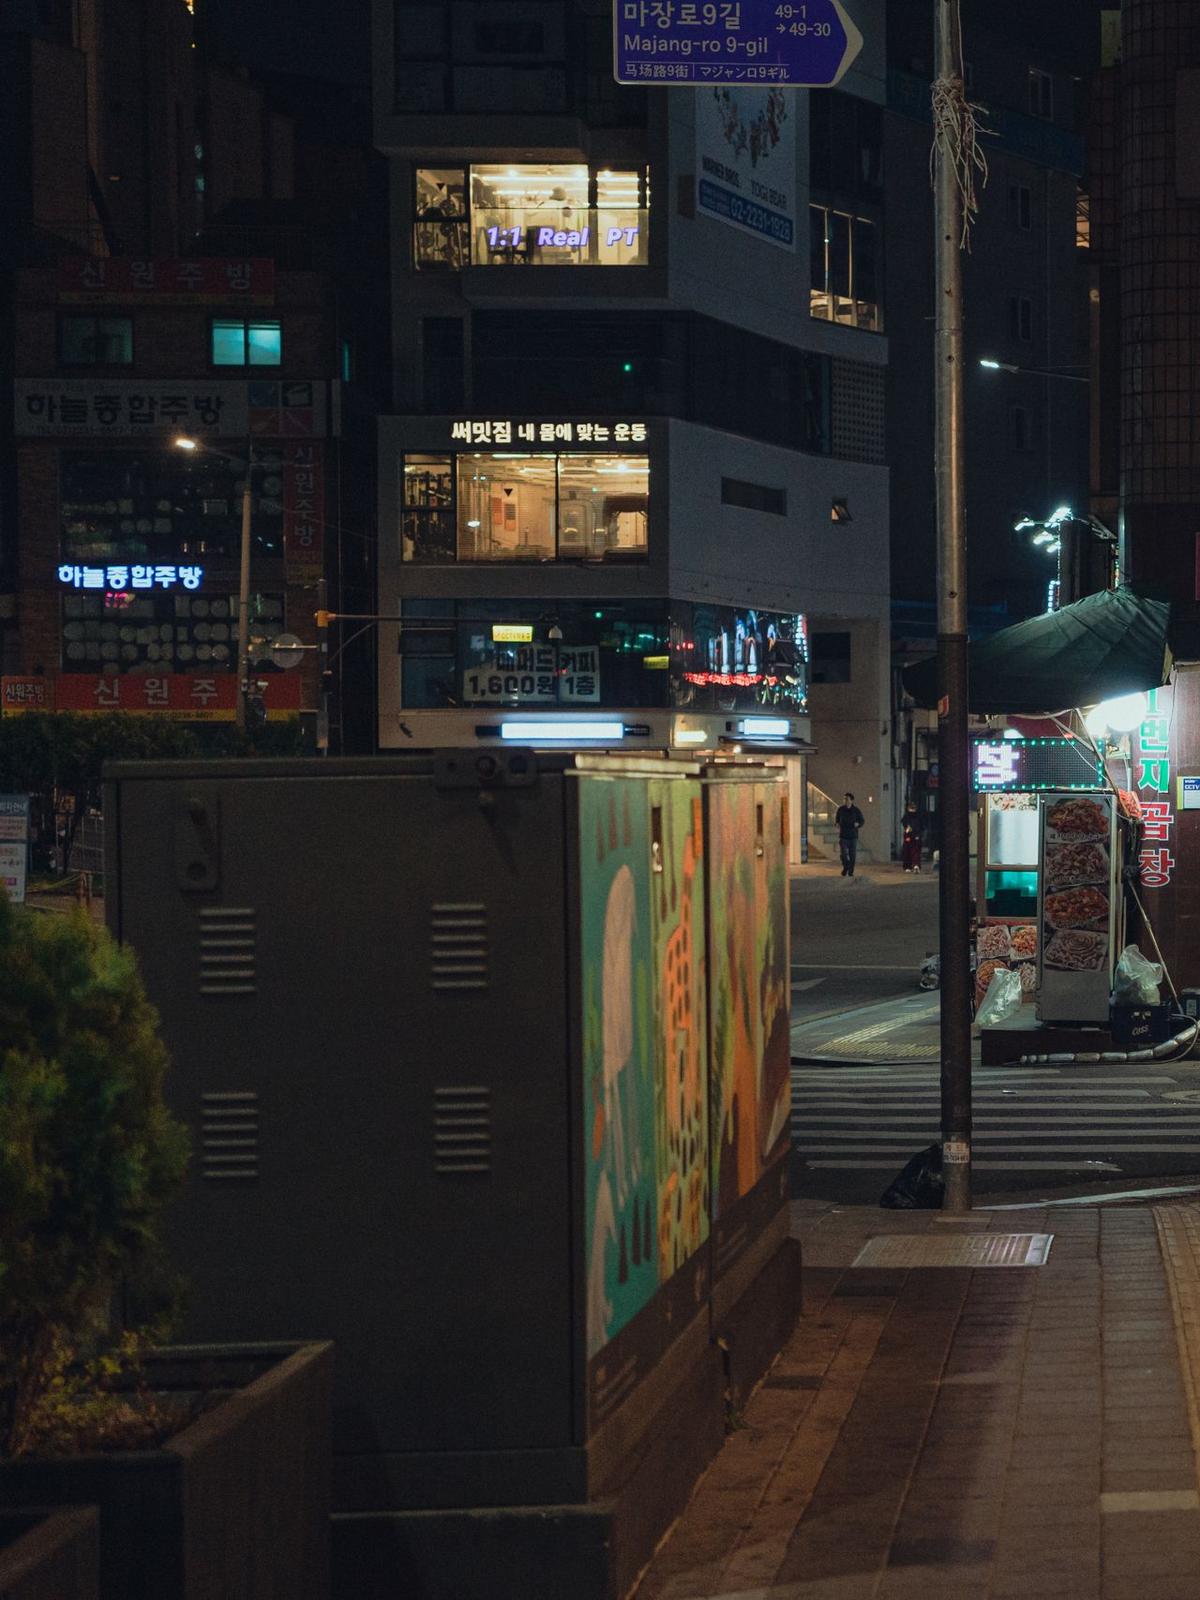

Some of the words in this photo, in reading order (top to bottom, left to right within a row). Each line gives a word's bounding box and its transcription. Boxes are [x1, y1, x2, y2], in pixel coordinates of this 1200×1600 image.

[624, 2, 742, 30] 마장로9길
[775, 4, 807, 20] 49-1
[789, 22, 831, 38] 49-30
[624, 35, 721, 55] Majang-ro
[726, 37, 768, 56] 9-gil
[625, 64, 689, 79] 马场路9街
[700, 65, 790, 80] マジャンロ9ギル
[486, 226, 521, 247] 1:1
[538, 225, 589, 247] Real
[607, 227, 640, 246] PT
[79, 260, 252, 290] 신원주방
[26, 393, 225, 425] 하늘종합주방
[451, 420, 512, 444] 써밋짐
[519, 423, 535, 441] 내
[540, 423, 572, 441] 몸에
[577, 423, 609, 442] 맞는
[614, 422, 647, 442] 운동
[57, 563, 204, 590] 하늘종합주방
[93, 678, 218, 705] 신원주
[469, 675, 555, 696] 1,600원
[566, 675, 596, 695] 1층
[1138, 800, 1175, 888] 곱창
